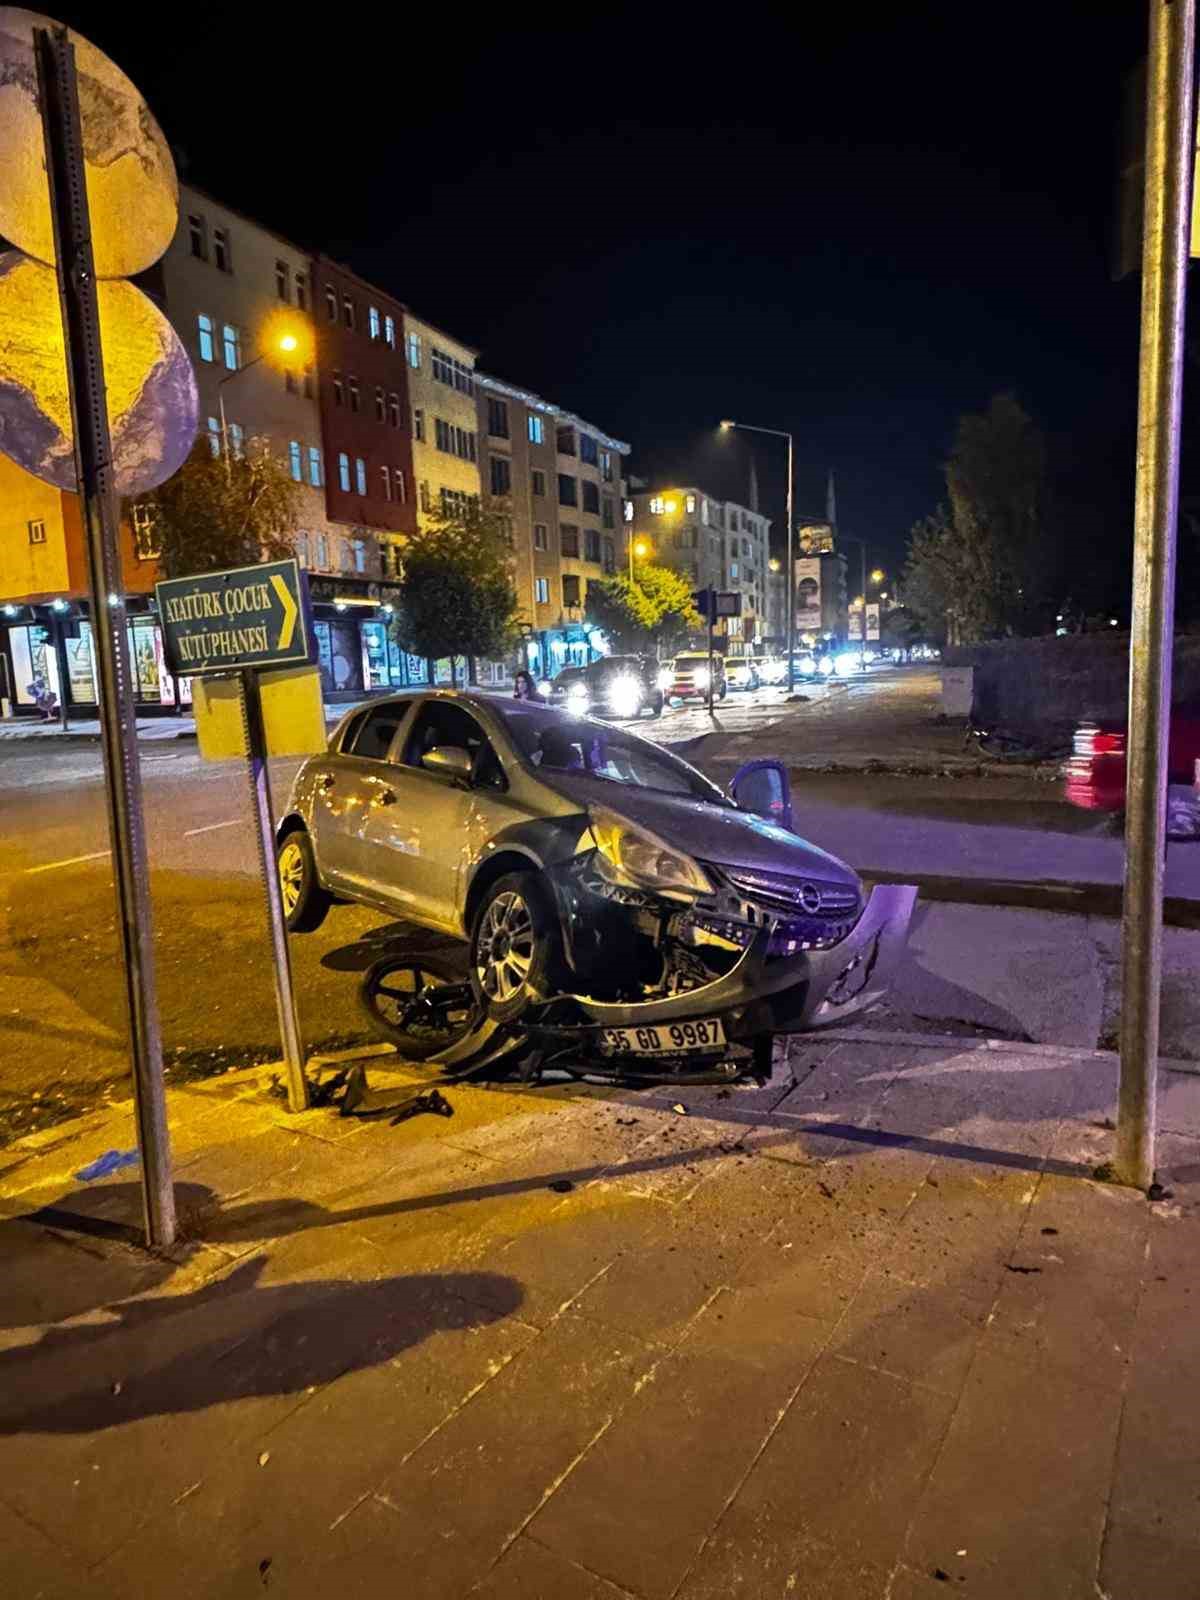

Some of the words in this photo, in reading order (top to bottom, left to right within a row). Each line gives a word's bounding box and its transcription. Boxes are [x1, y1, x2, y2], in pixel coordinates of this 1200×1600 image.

[166, 588, 223, 623] ATATÜRK
[224, 584, 272, 621] ÇOCUK
[178, 620, 269, 661] KÜTÜPHANESİ
[607, 1030, 631, 1050] 35
[636, 1027, 661, 1049] GD
[669, 1020, 719, 1047] 9987
